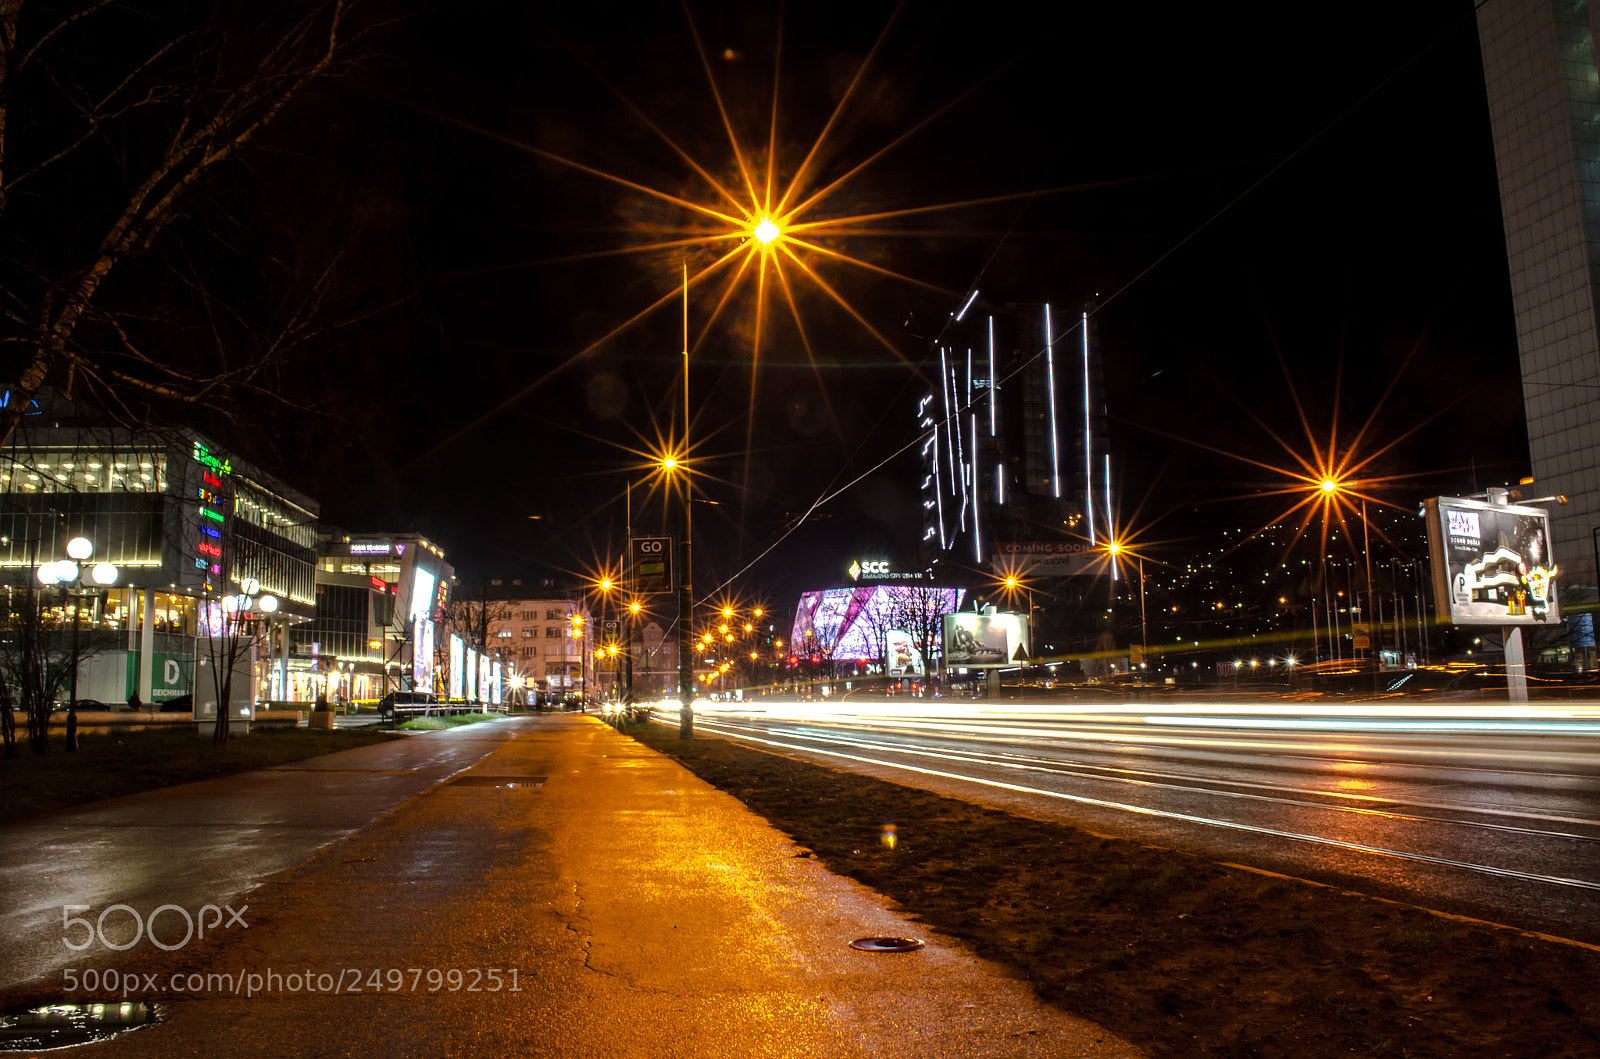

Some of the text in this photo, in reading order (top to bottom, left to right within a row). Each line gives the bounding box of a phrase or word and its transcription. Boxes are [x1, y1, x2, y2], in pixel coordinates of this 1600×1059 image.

[640, 541, 662, 553] GO
[1006, 543, 1090, 553] COMING SOON
[861, 561, 889, 574] SCC
[164, 659, 180, 685] D
